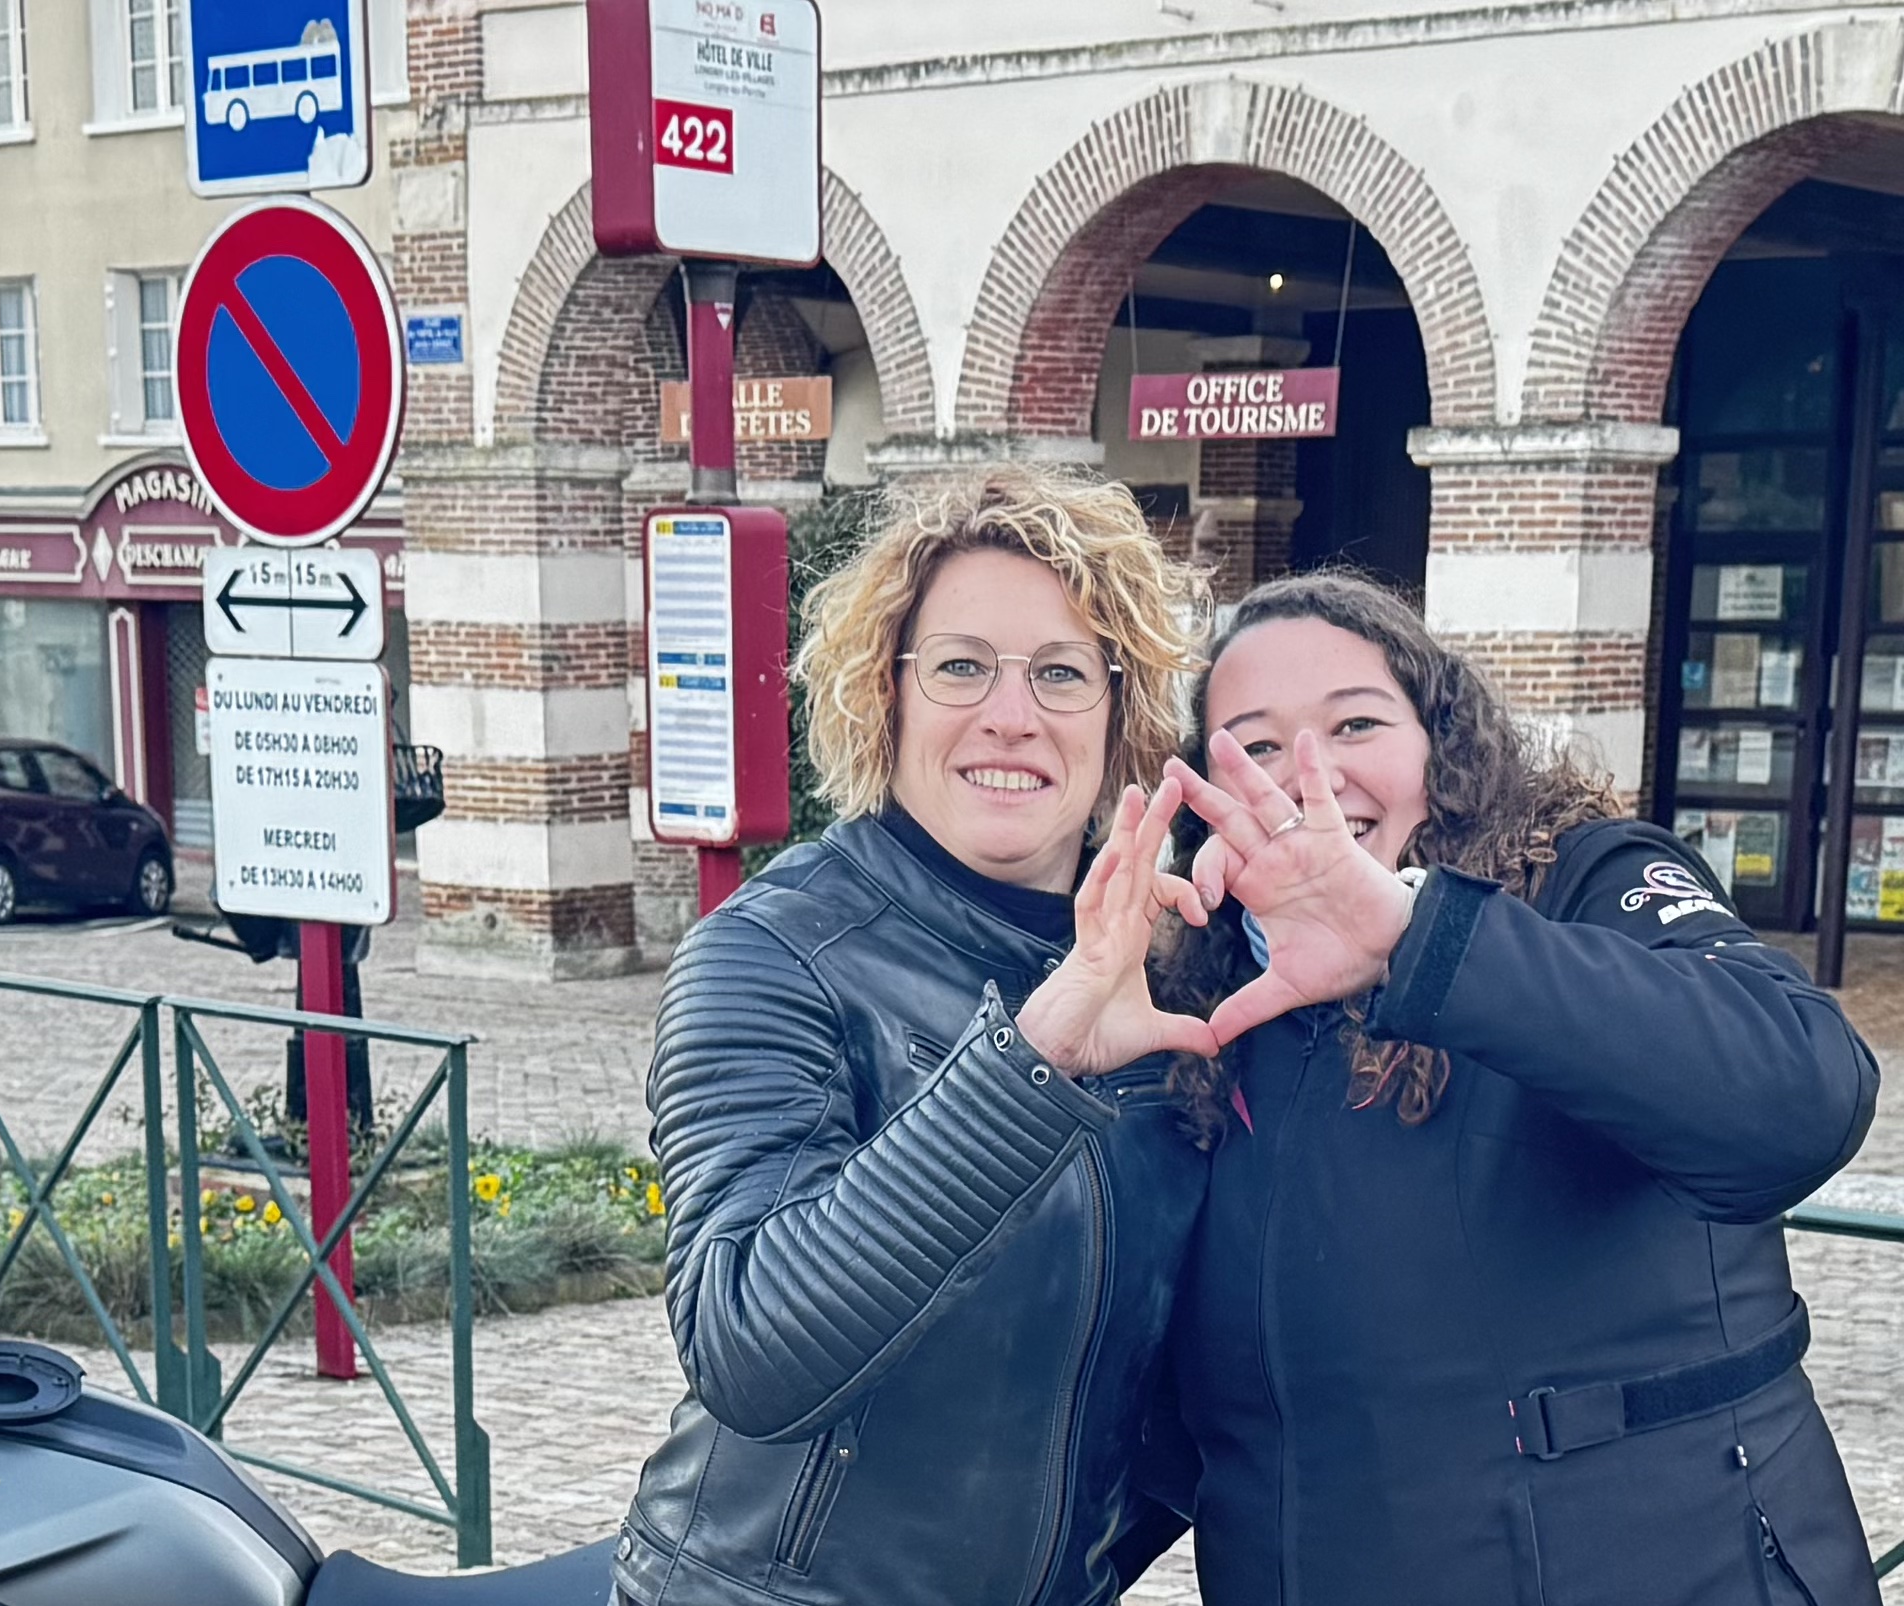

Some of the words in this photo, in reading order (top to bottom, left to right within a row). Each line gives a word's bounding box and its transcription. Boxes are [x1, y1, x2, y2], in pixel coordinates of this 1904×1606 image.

[697, 37, 727, 66] HÔTEL
[731, 47, 742, 68] DE
[746, 50, 772, 72] VILLE
[661, 114, 727, 164] 422
[1187, 373, 1284, 405] OFFICE
[734, 408, 811, 437] FÊTES
[1140, 408, 1179, 437] DE
[1184, 402, 1326, 436] TOURISME
[214, 690, 232, 709] DU
[235, 691, 278, 711] LUNDI
[282, 692, 301, 713] AU
[303, 694, 377, 716] VENDREDI
[235, 730, 253, 751] DE
[301, 734, 311, 753] A
[314, 734, 358, 756] 08H00
[236, 765, 254, 785] DE
[258, 766, 300, 787] 17H15
[303, 768, 312, 788] A
[315, 770, 359, 790] 20H30
[264, 828, 336, 852] MERCREDI
[241, 865, 258, 885] DE
[262, 867, 304, 888] 13H30
[307, 870, 316, 889] A
[319, 871, 363, 893] 14H00
